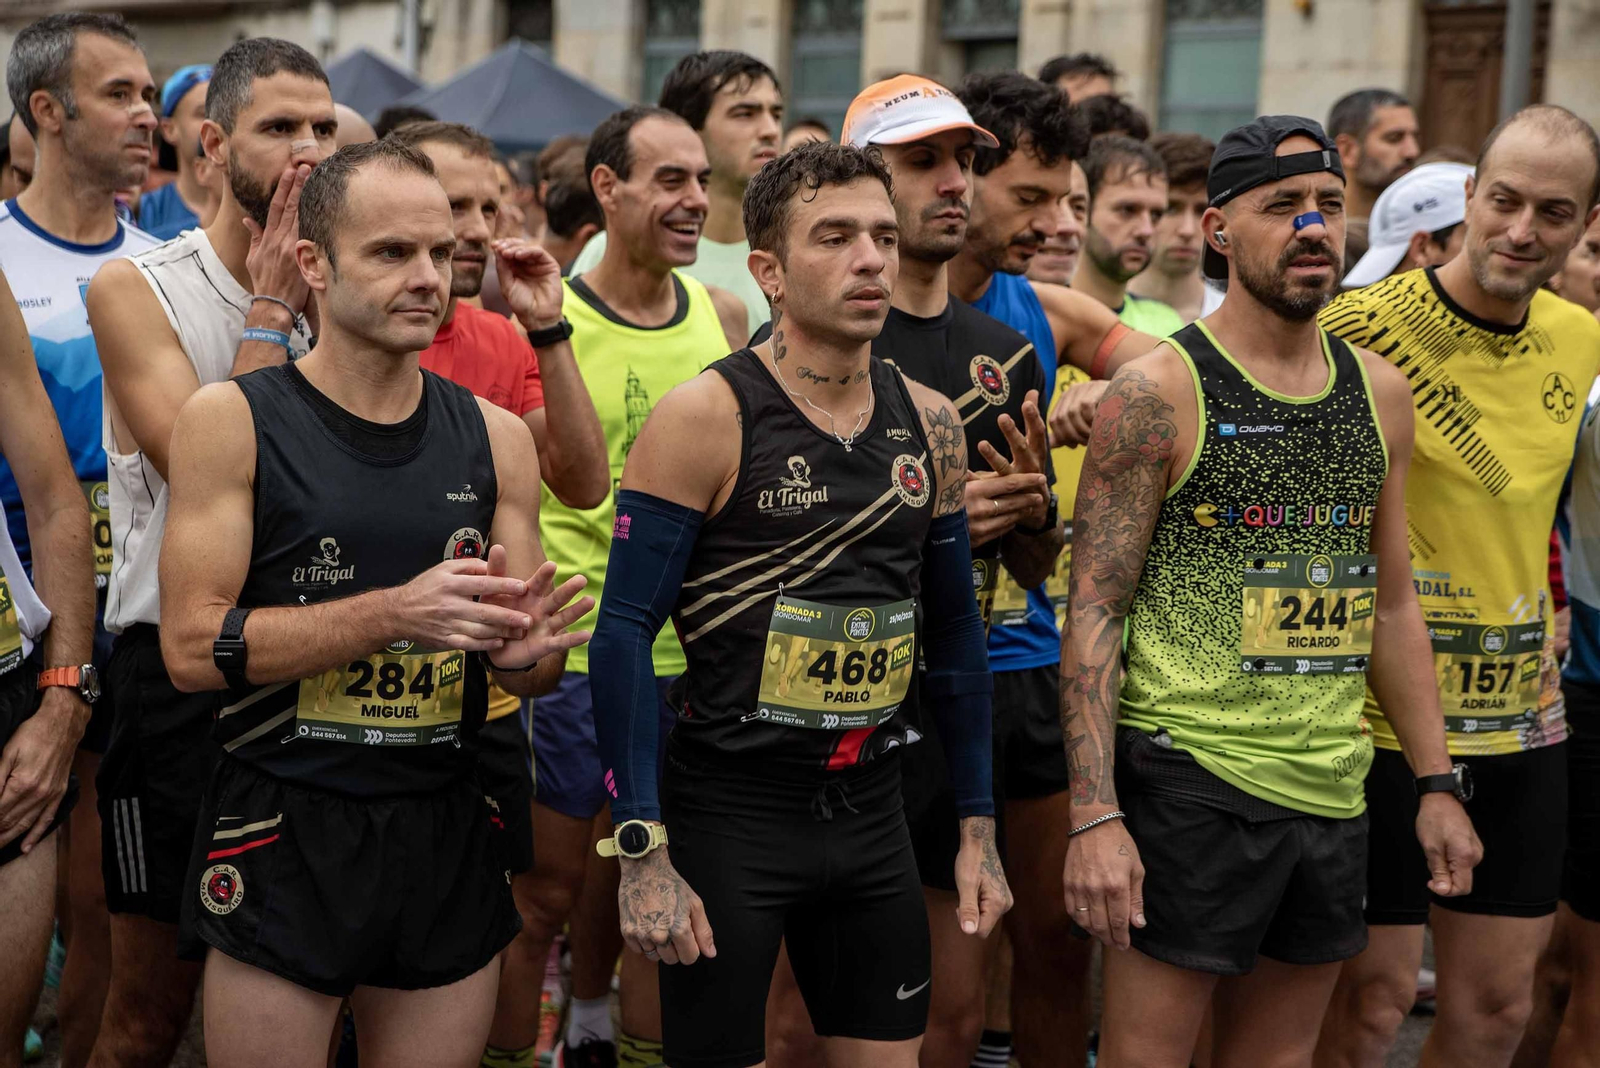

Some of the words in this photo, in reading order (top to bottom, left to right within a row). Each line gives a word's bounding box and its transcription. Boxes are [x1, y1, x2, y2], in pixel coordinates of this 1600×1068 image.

[757, 490, 773, 509] El
[777, 485, 829, 510] Trigal
[1303, 505, 1374, 527] JUGUE
[292, 566, 305, 583] El
[308, 564, 355, 585] Trigal
[773, 610, 812, 623] GONDOMAR
[775, 603, 815, 618] XORNADA
[816, 611, 822, 619] 3
[1280, 595, 1348, 631] 244
[1353, 597, 1373, 612] 10K
[1287, 636, 1340, 648] RICARDO
[807, 648, 888, 686] 468
[893, 642, 911, 662] 10K
[345, 660, 435, 701] 284
[441, 658, 460, 678] 10K
[1460, 662, 1515, 694] 157
[823, 690, 870, 703] PABLO
[1460, 695, 1506, 709] ADRIÁN
[361, 704, 420, 719] MIGUEL
[841, 714, 869, 722] Deputación
[384, 736, 417, 744] Pontevedra
[385, 731, 417, 739] Deputación
